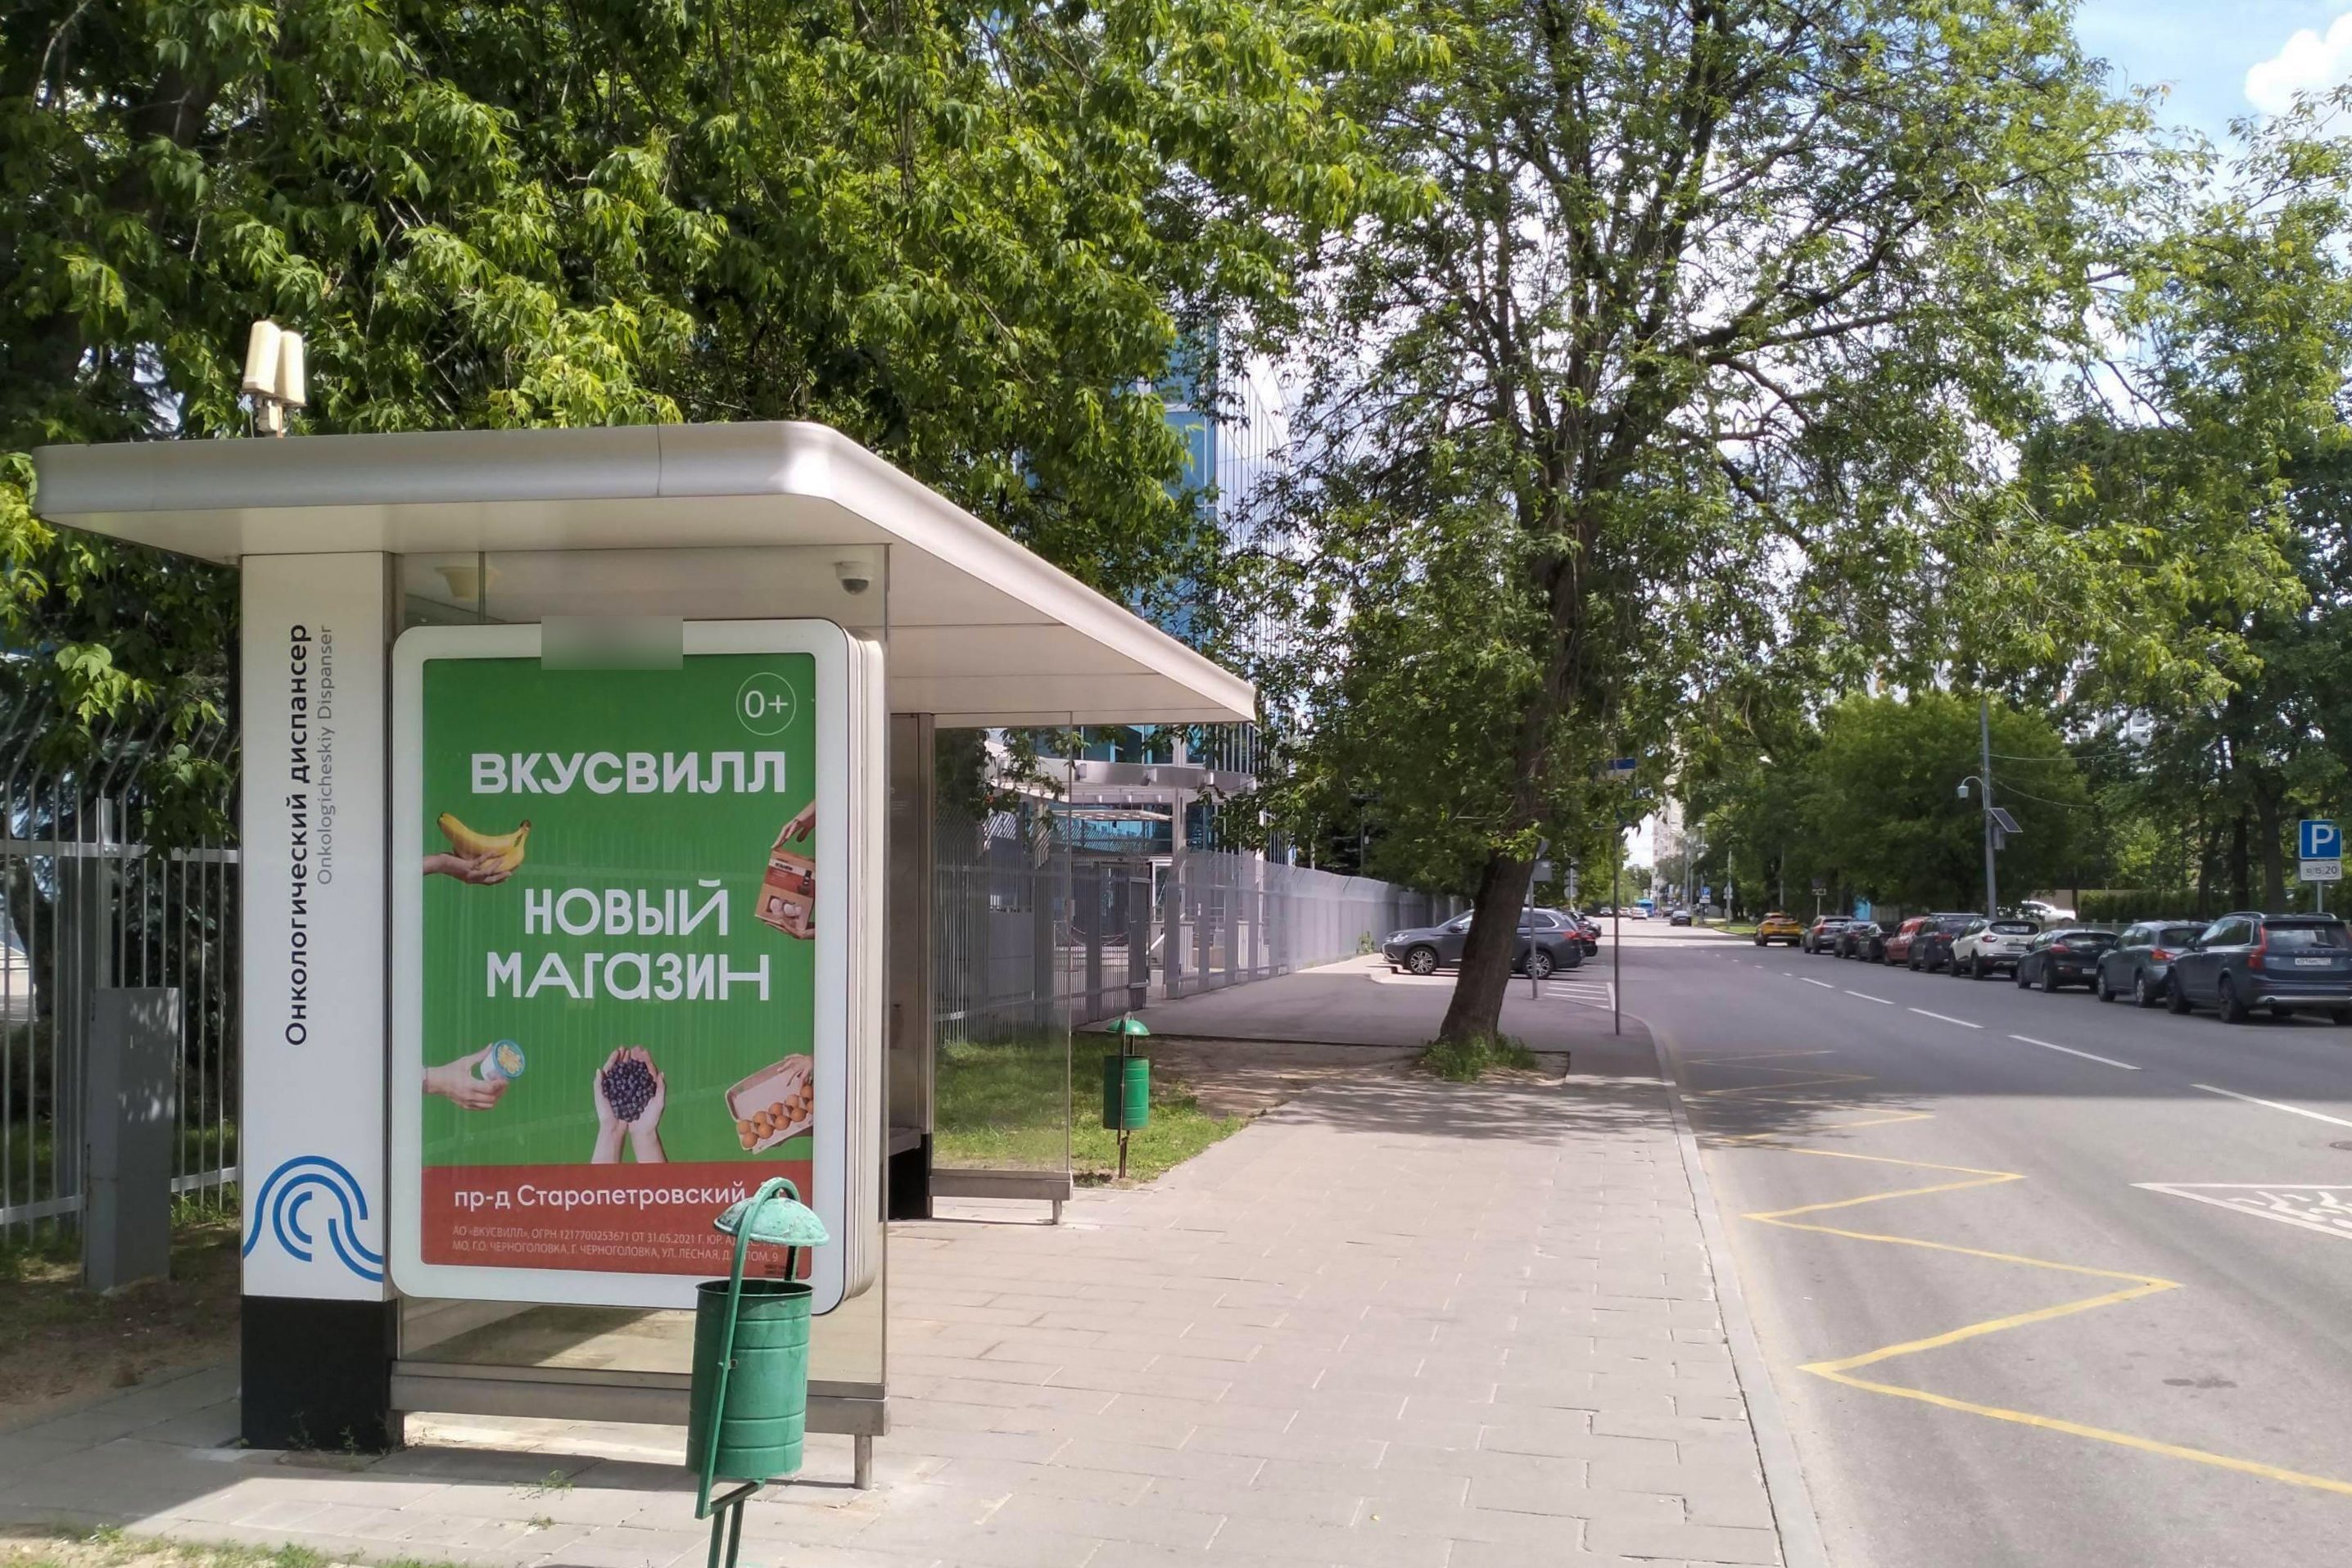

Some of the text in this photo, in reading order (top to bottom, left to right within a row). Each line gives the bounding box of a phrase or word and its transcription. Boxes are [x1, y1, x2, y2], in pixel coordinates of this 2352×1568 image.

[744, 690, 789, 718] 0+
[317, 626, 336, 885] Onkologicheskiy Dispanser
[471, 751, 786, 794] ВКУСВИЛЛ
[284, 624, 312, 1046] Онкологический диспансер
[2311, 825, 2335, 855] P
[2325, 865, 2337, 874] 20
[524, 879, 729, 936] НОВЫЙ
[455, 1187, 510, 1212] пр-д
[452, 1226, 468, 1236] АО
[531, 1228, 558, 1239] ОГРН
[560, 1229, 629, 1241] 1217700253671
[631, 1231, 645, 1242] ОТ
[648, 1232, 695, 1244] 31.05.2021
[707, 1235, 723, 1245] ЮР.
[490, 1241, 570, 1255] ЧЕРНОГОЛОВКА,
[580, 1245, 660, 1259] ЧЕРНОГОЛОВКА,
[662, 1248, 676, 1258] УЛ.
[679, 1248, 720, 1260] ЛЕСНАЯ,
[772, 1252, 779, 1263] 9
